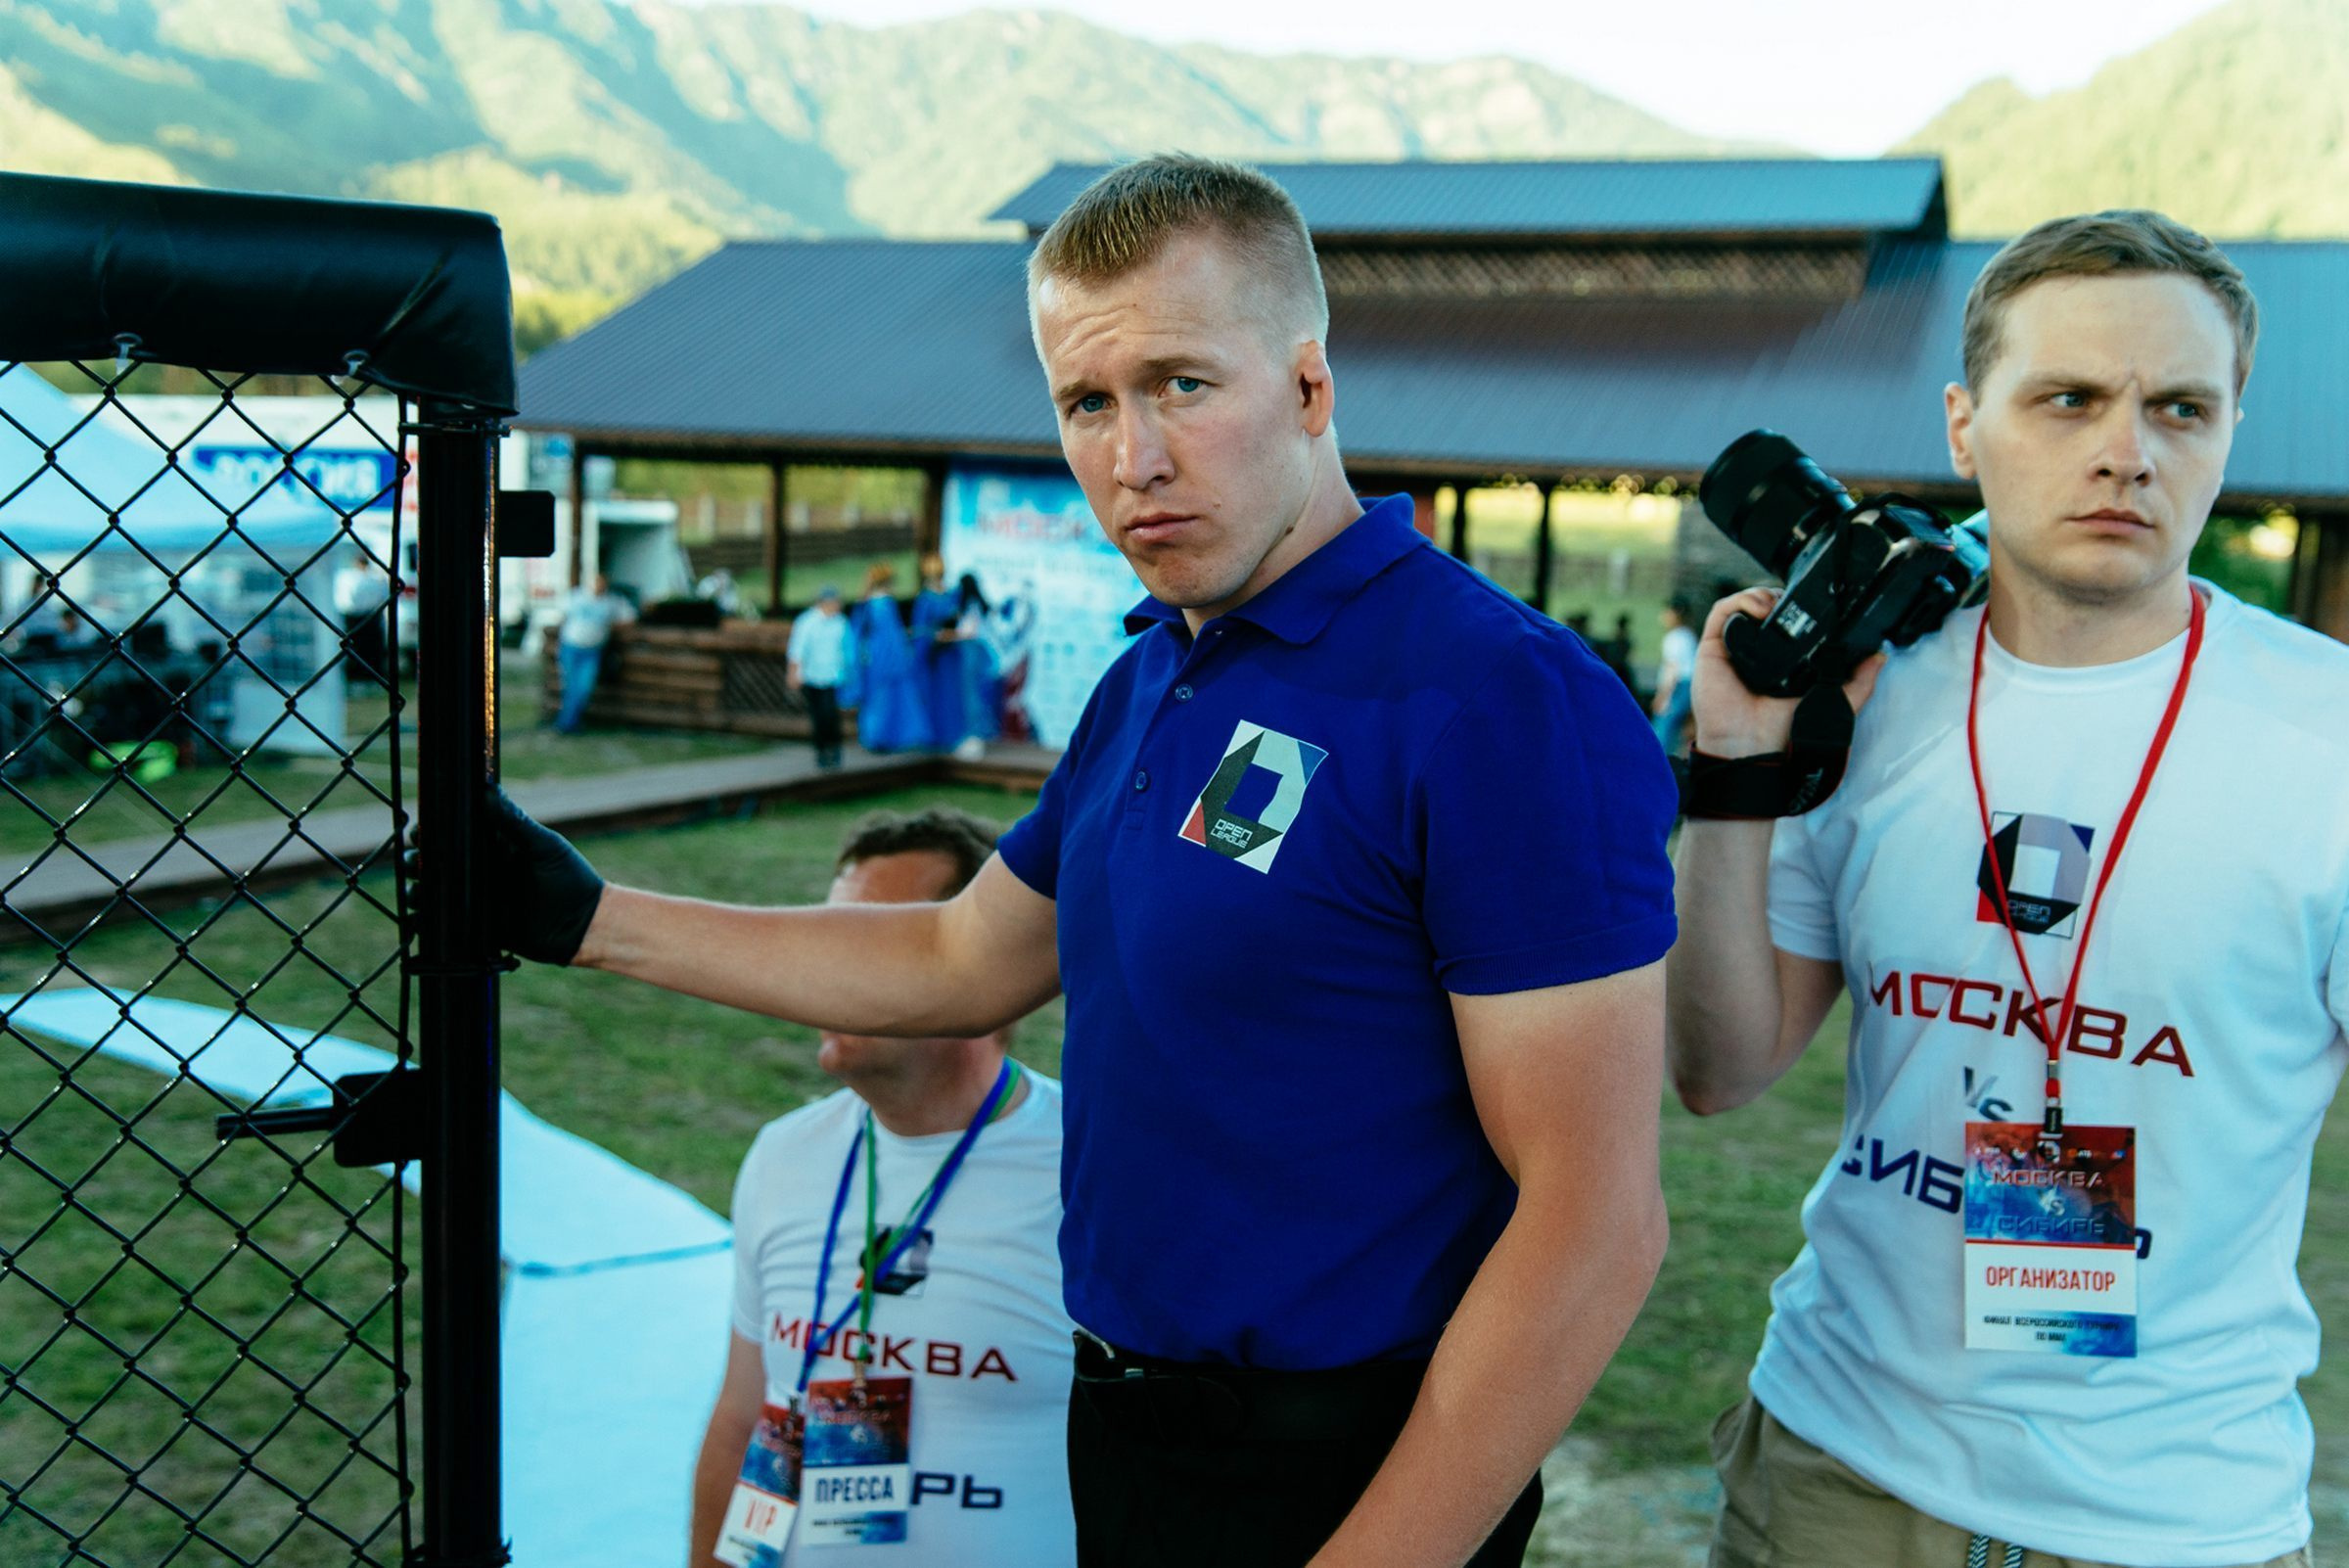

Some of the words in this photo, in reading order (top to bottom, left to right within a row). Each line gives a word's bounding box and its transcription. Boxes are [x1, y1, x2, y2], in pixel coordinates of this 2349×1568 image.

[1210, 828, 1248, 849] LEAGUE
[1214, 818, 1253, 842] OPEN
[1993, 1169, 2103, 1189] МОСКВА
[1985, 1266, 2116, 1292] ОРГАНИЗАТОР
[771, 1312, 1018, 1383] МОСКВА
[814, 1476, 895, 1503] ПРЕССА
